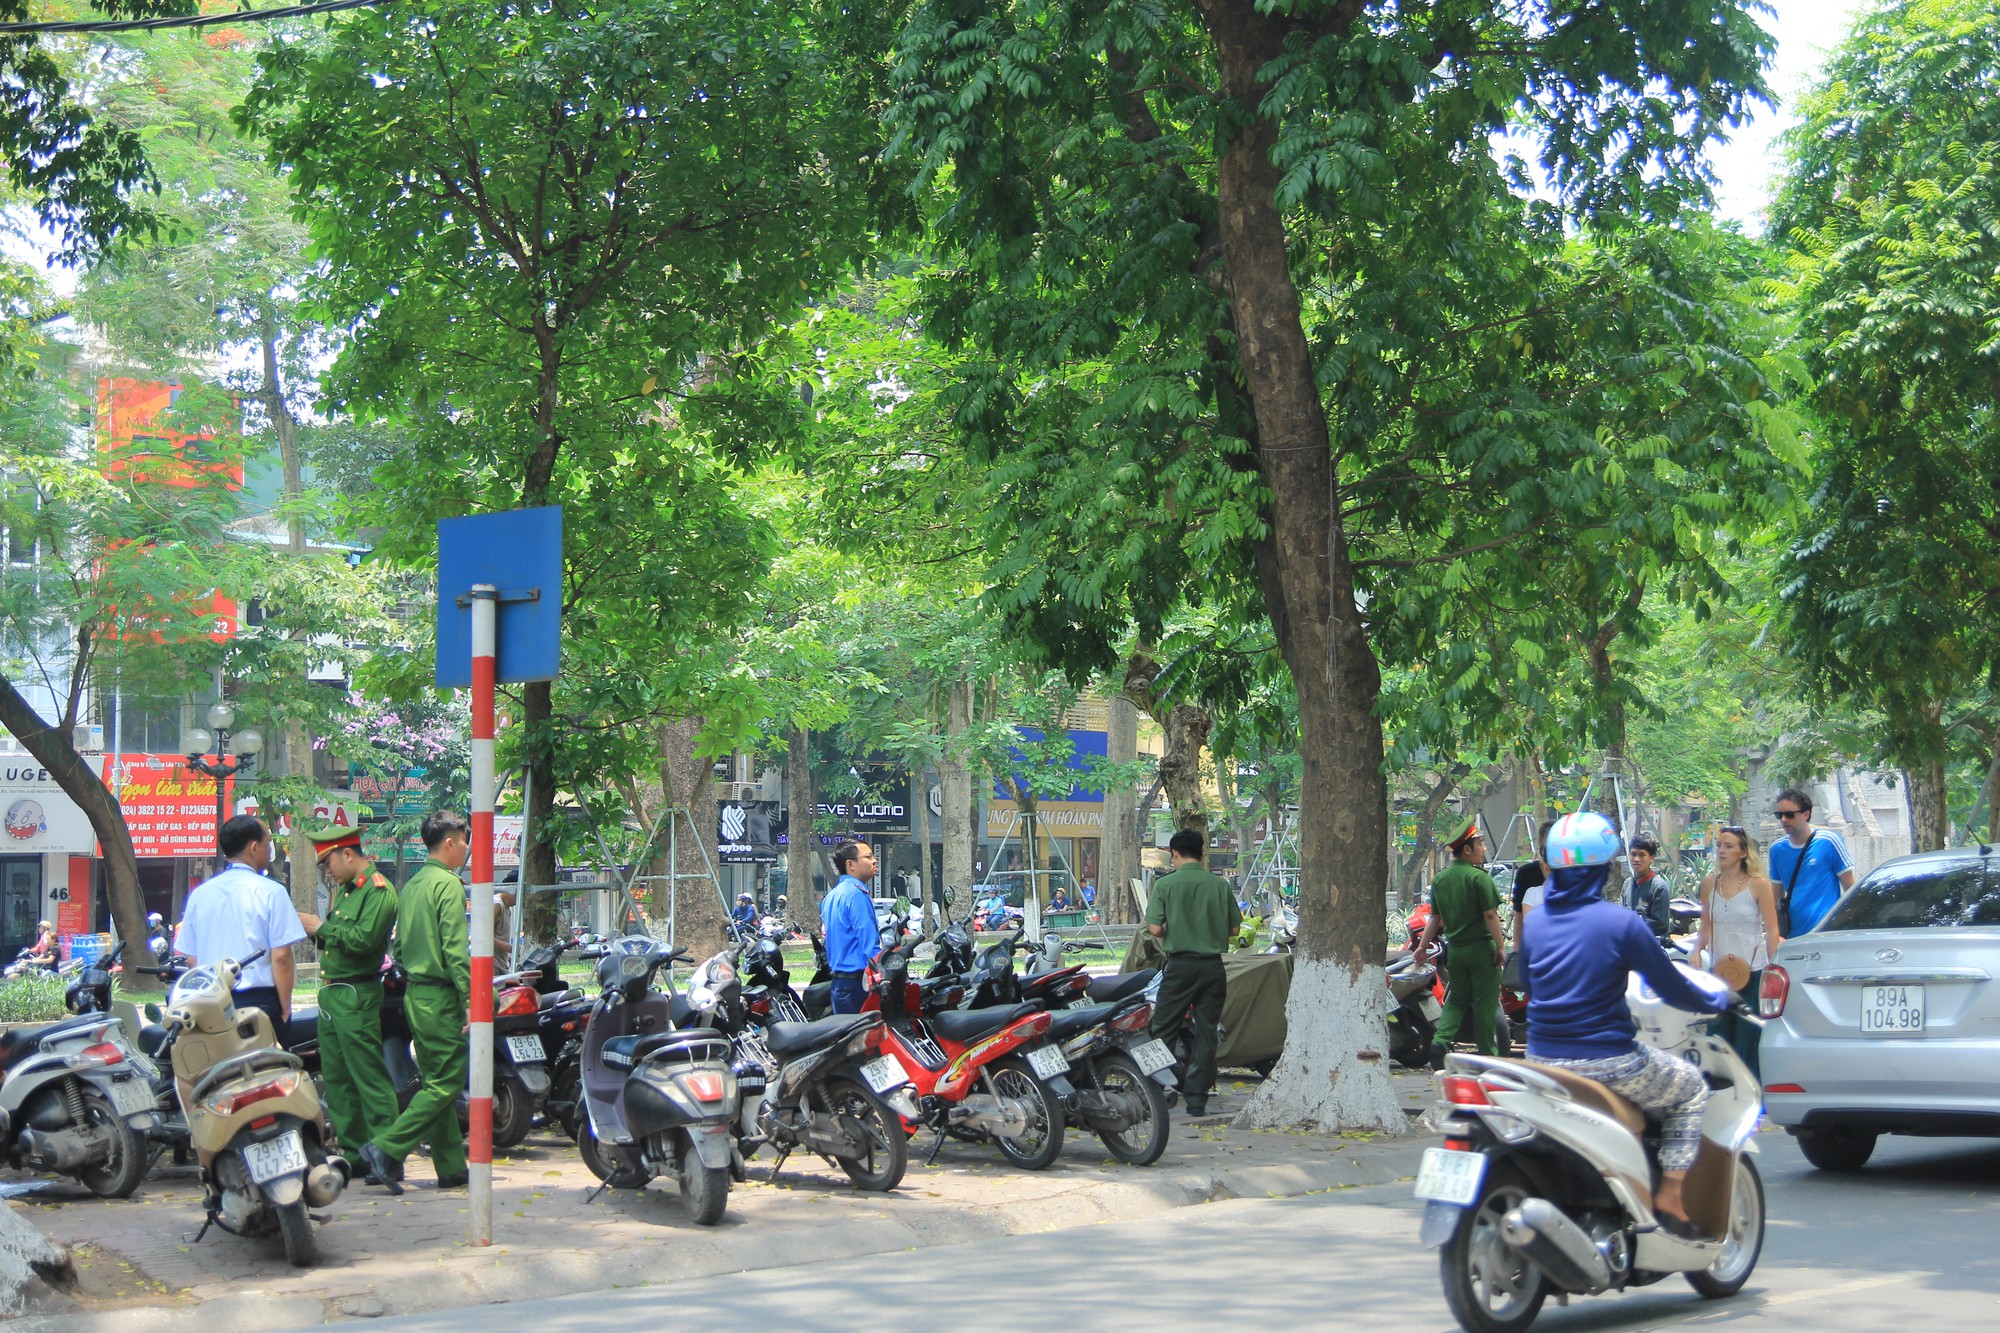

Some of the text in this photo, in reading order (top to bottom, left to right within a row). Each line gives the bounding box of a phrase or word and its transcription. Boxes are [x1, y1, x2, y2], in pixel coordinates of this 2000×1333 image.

[0, 768, 56, 781] UGE
[138, 805, 155, 816] 3822
[156, 805, 165, 816] 15
[166, 805, 175, 816] 22
[180, 805, 218, 816] 012345678
[987, 809, 1011, 825] UNG
[127, 821, 137, 830] ẤP
[156, 820, 168, 830] BẾP
[169, 822, 182, 830] GAS
[187, 820, 200, 830] BẾP
[49, 887, 69, 901] 46
[1876, 987, 1908, 1007] 89A
[1865, 1008, 1921, 1029] 104.98
[512, 1036, 537, 1049] 29-G1
[515, 1047, 544, 1060] 454.23
[1143, 1053, 1171, 1071] 5132
[254, 1136, 293, 1162] 29-P1
[256, 1150, 303, 1179] 447.52
